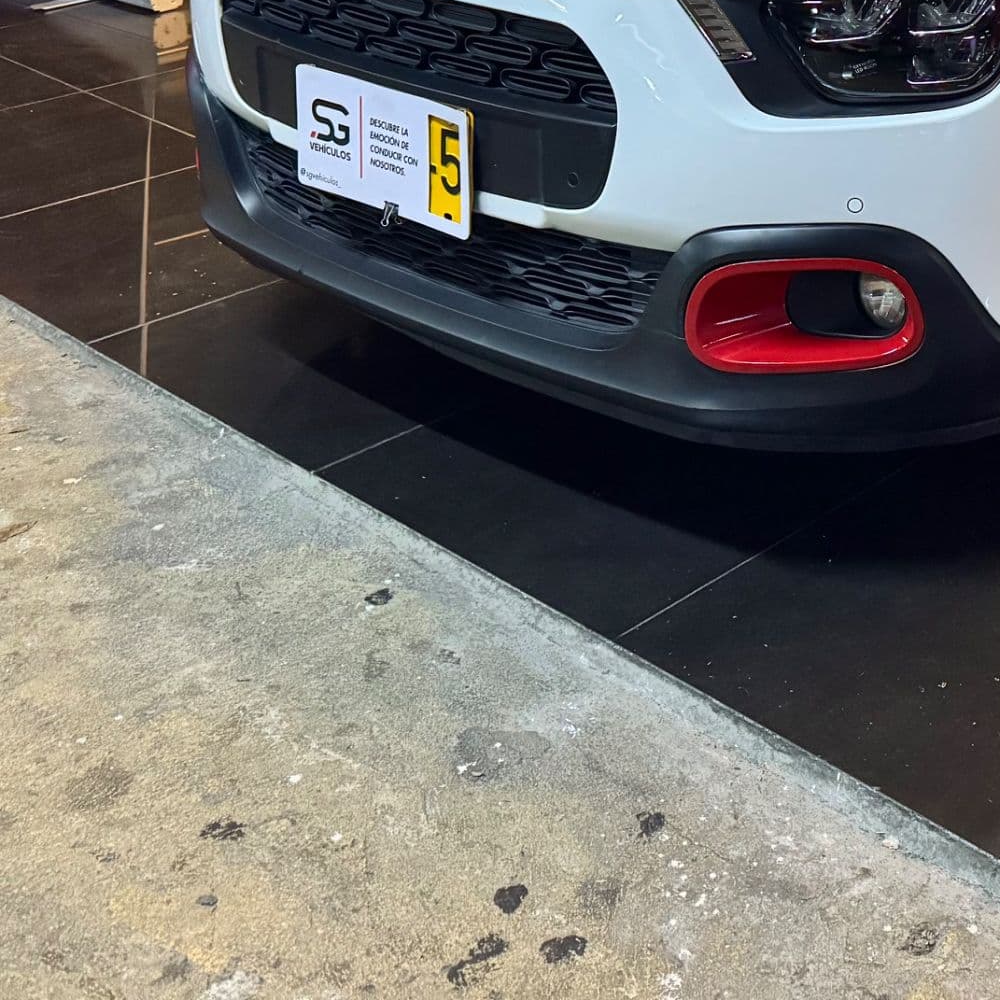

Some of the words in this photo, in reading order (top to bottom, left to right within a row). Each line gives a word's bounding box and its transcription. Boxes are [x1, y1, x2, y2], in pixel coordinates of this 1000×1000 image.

[369, 117, 400, 135] DESCUBRE
[401, 127, 409, 137] LA
[309, 141, 352, 161] VEHÍCULOS
[370, 144, 402, 160] CONDUCIR
[403, 155, 419, 167] CON
[401, 140, 409, 151] DE
